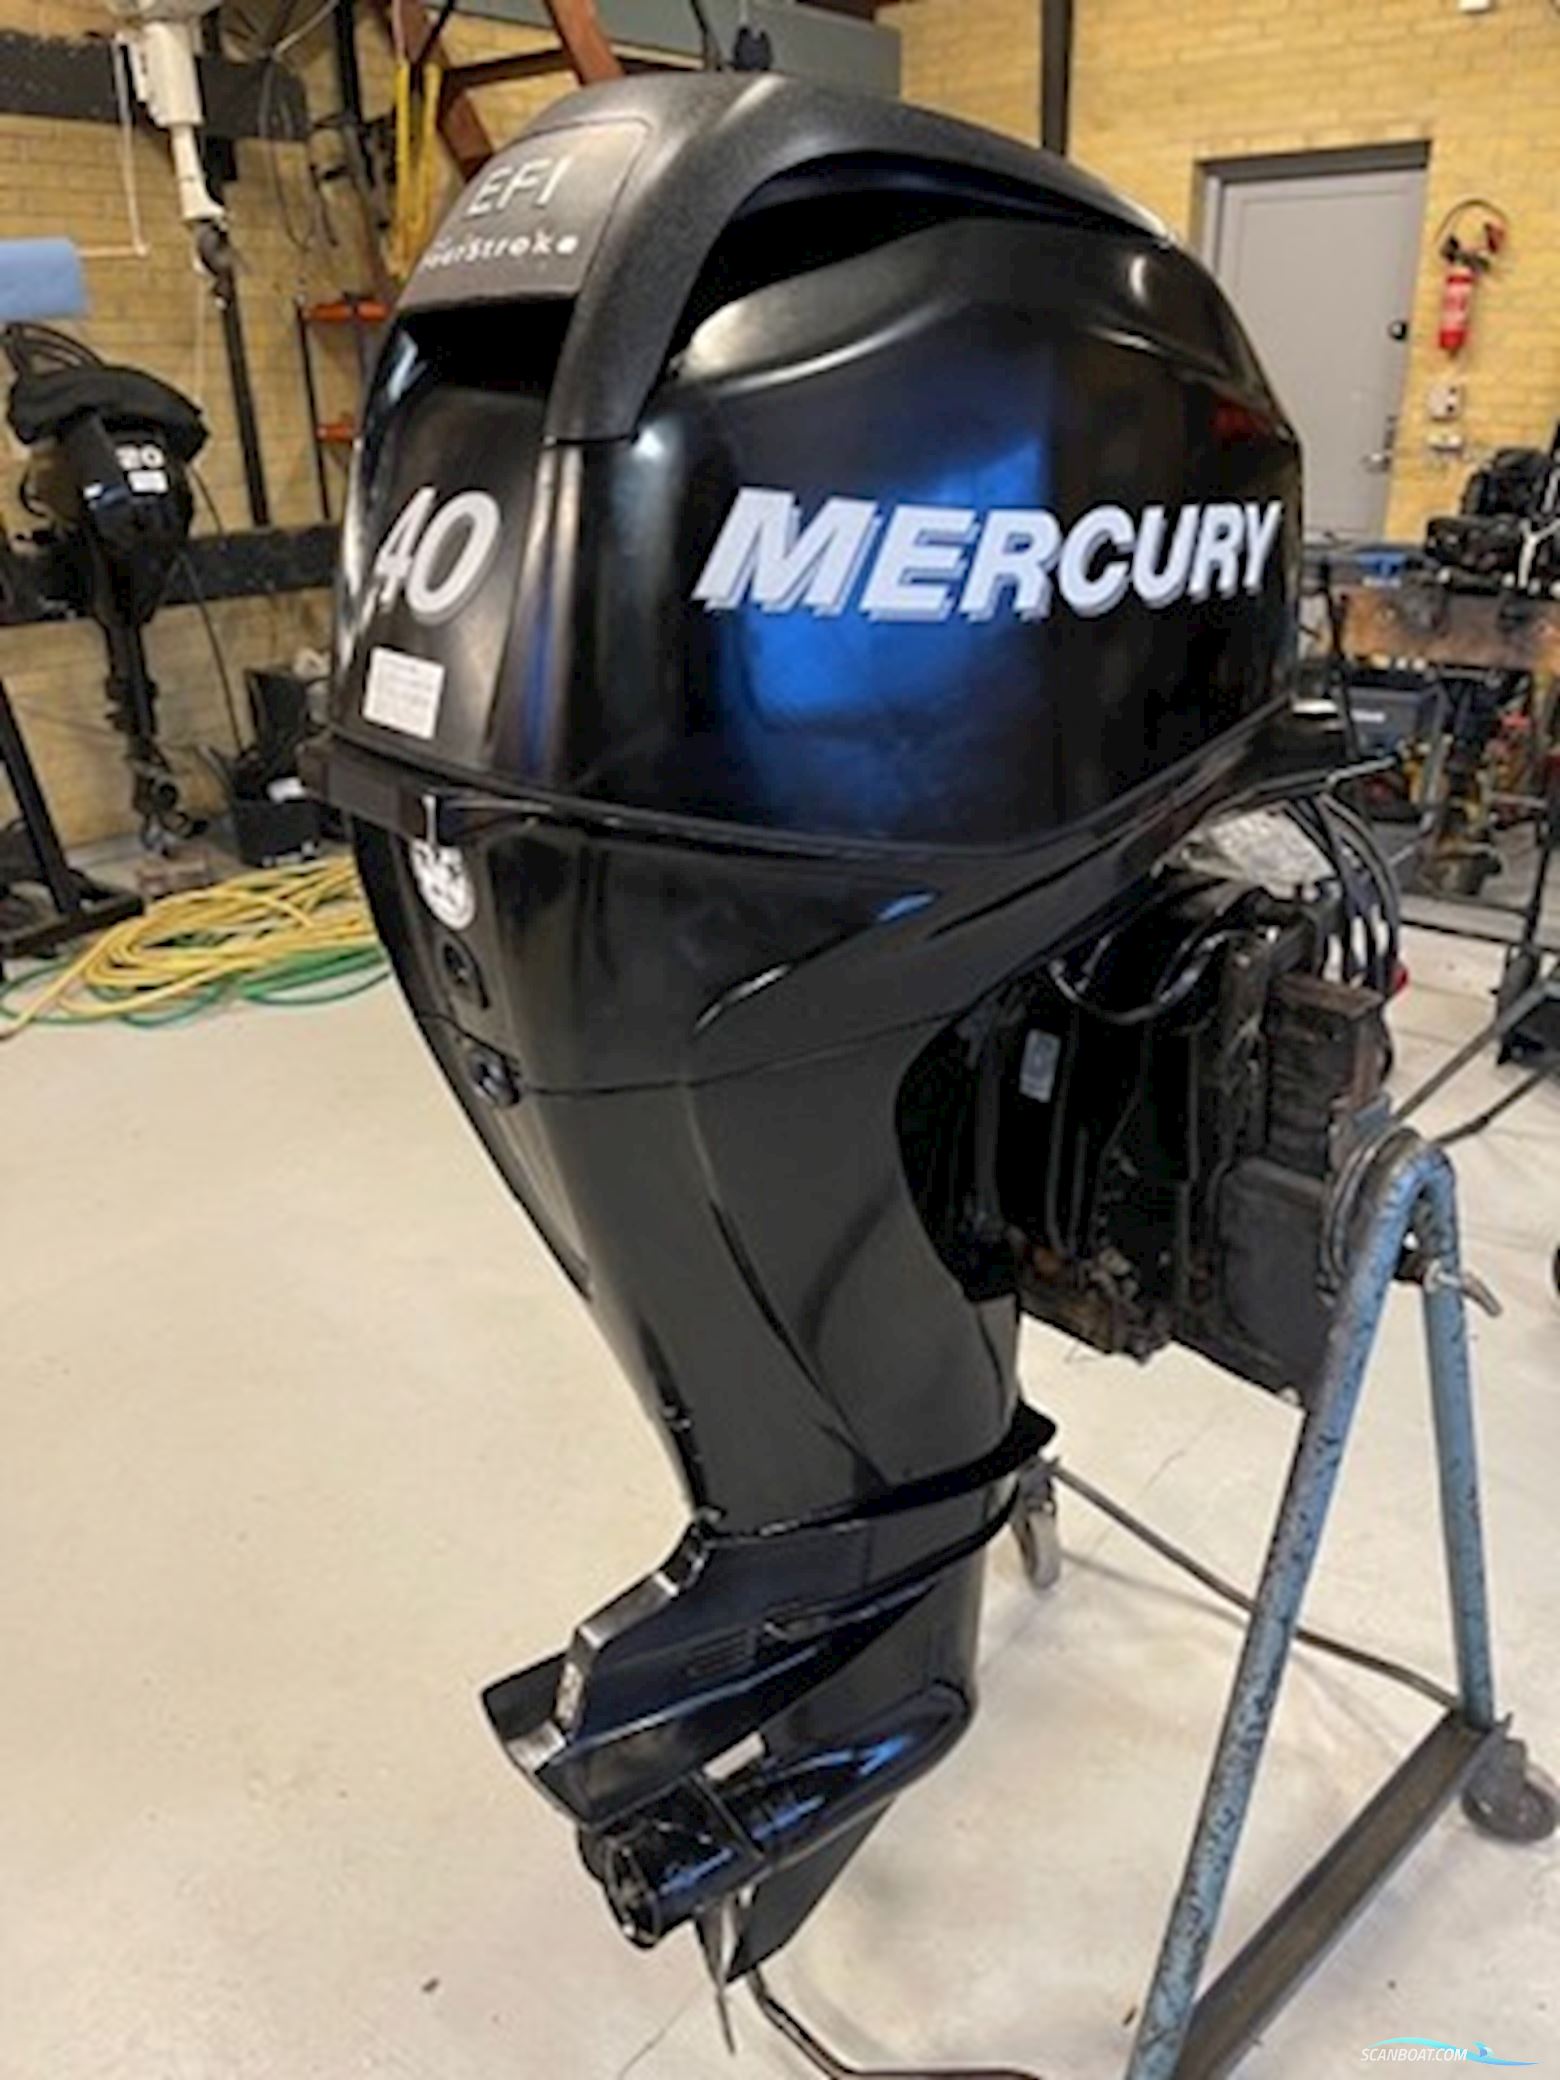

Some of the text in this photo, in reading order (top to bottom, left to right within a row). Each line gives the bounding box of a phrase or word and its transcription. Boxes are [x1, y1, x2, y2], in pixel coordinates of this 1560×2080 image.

[465, 155, 575, 217] EFI
[373, 485, 500, 622] 40
[691, 485, 1283, 623] MERCURY
